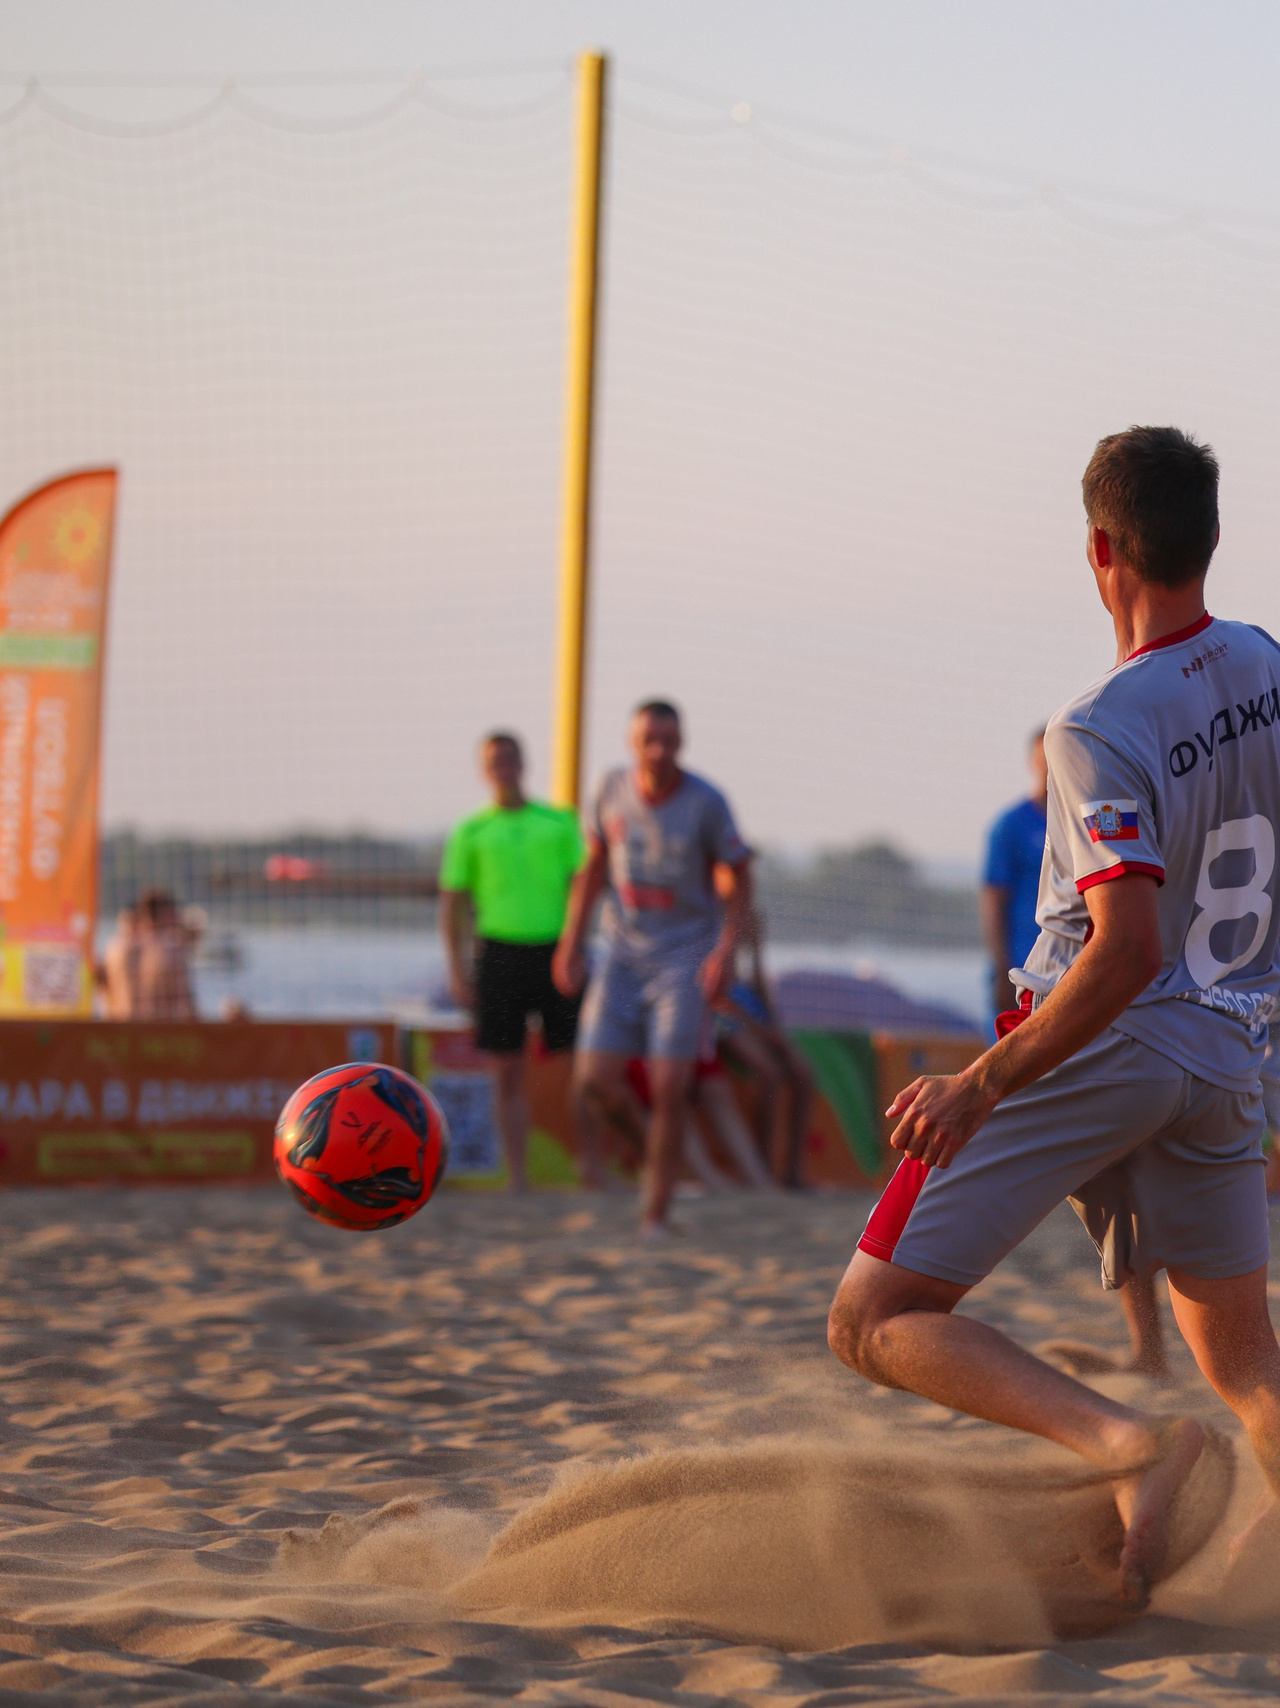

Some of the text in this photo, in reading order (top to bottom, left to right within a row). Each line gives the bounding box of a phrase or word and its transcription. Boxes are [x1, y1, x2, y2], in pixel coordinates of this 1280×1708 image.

[1202, 643, 1228, 662] SPORT
[1184, 813, 1276, 990] 8
[102, 1078, 130, 1121] В
[136, 1078, 297, 1126] ДВИЖЕ
